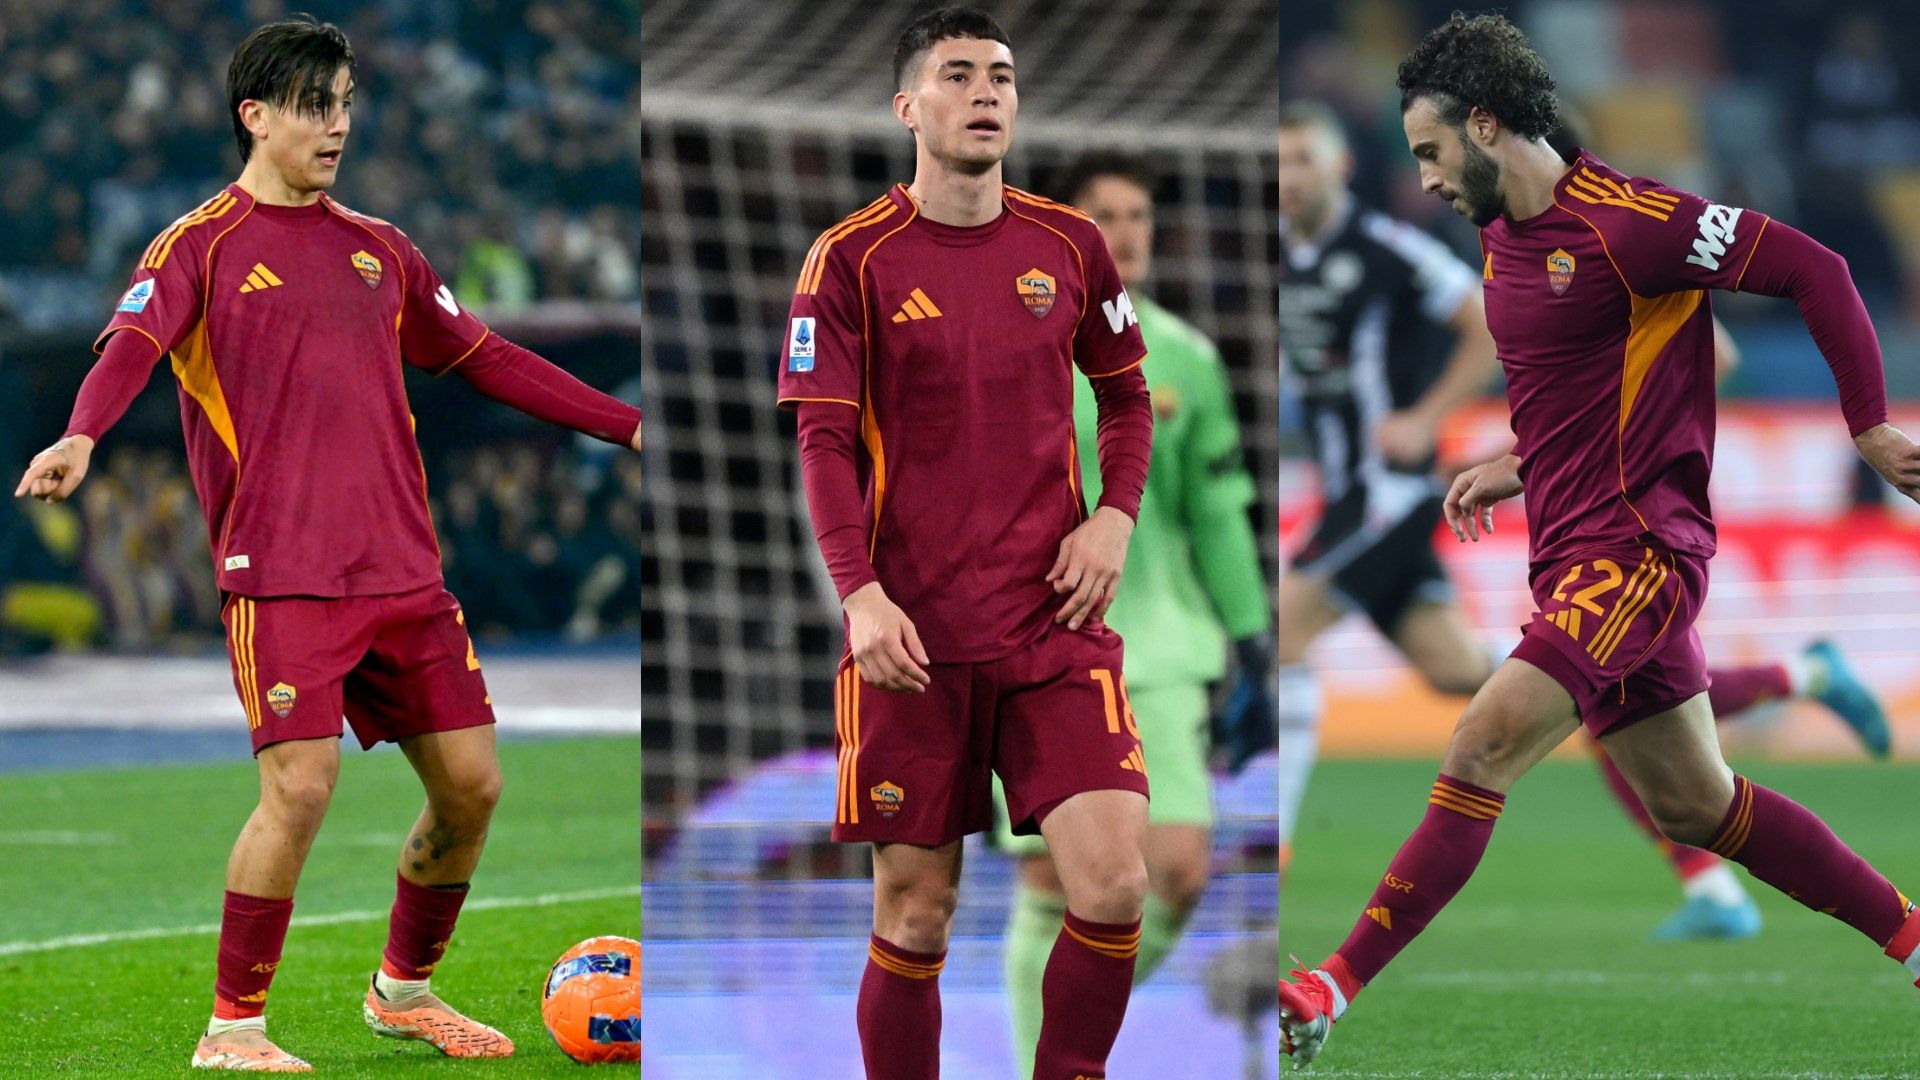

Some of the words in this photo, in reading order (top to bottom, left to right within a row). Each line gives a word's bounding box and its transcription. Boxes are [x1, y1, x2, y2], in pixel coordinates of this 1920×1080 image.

[1550, 275, 1571, 284] ROMA
[1024, 297, 1052, 305] ROMA
[1552, 558, 1624, 617] 22
[272, 702, 293, 711] ROMA
[875, 803, 900, 811] ROMA
